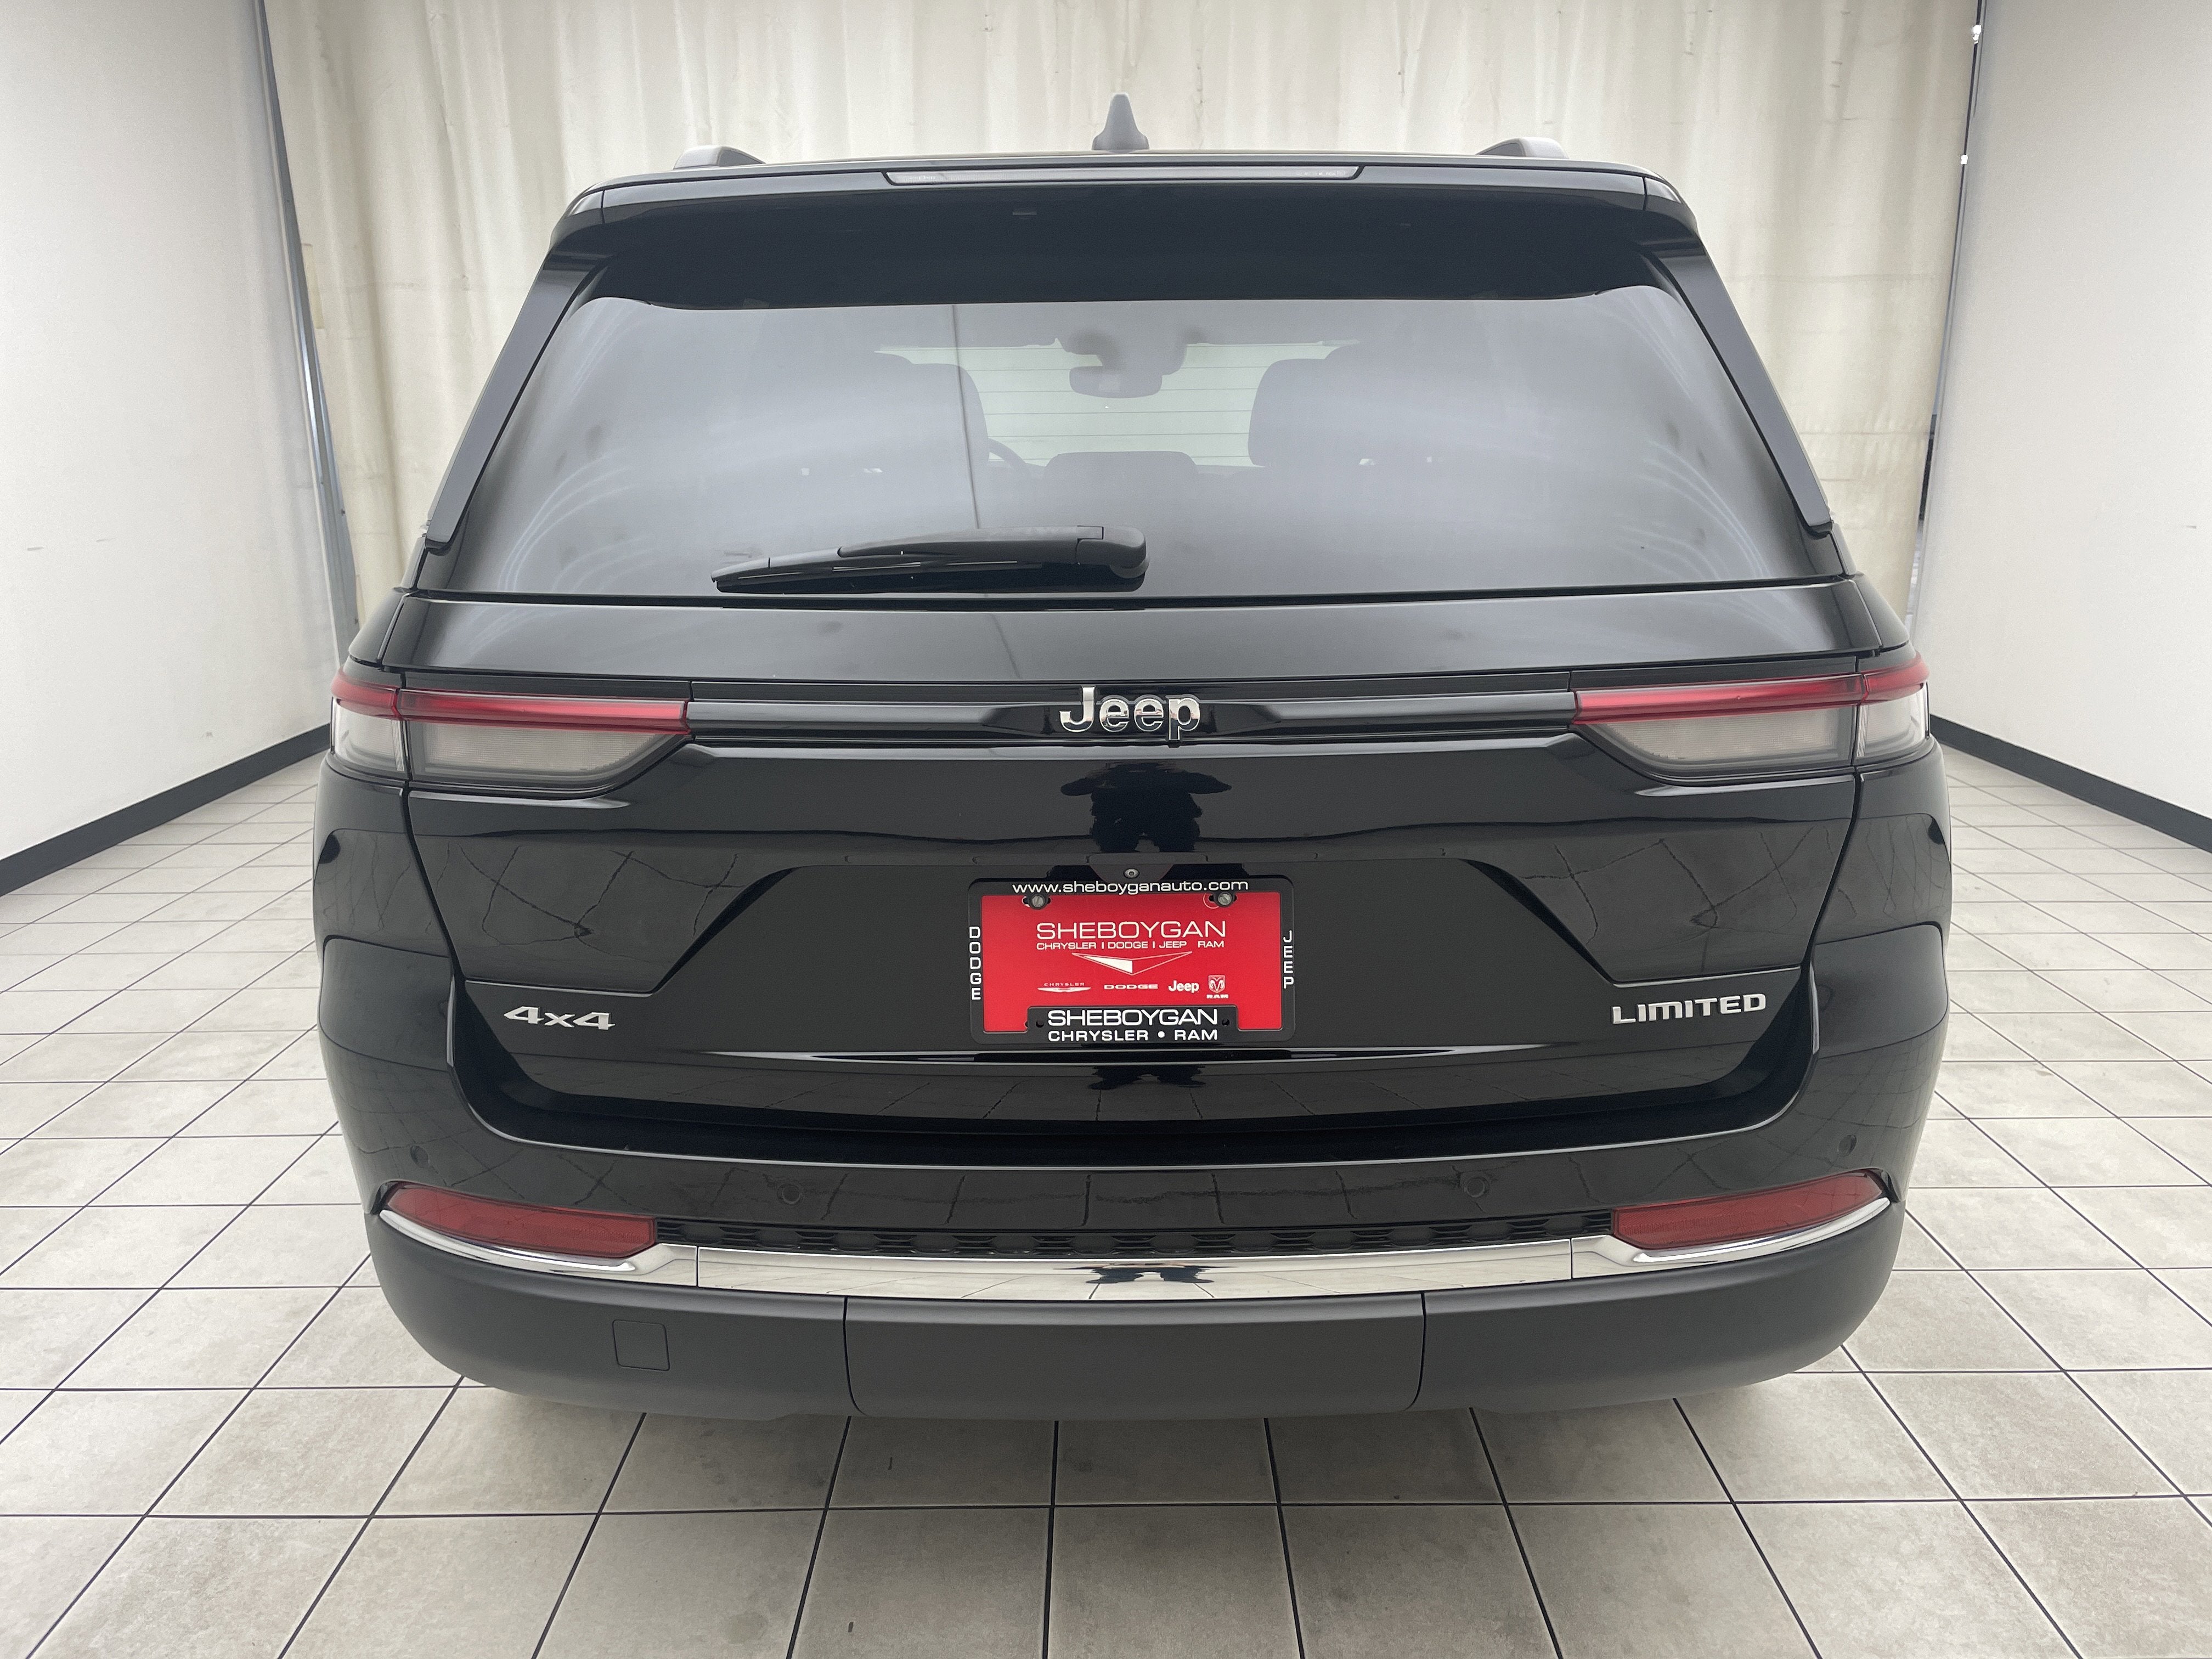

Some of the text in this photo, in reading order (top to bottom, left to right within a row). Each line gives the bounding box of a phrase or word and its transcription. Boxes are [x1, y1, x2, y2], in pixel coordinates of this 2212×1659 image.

[1059, 686, 1200, 741] Jeep
[1012, 881, 1249, 895] www.sheboyganauto.com
[1036, 921, 1226, 939] SHEBOYGAN
[969, 926, 981, 1000] DODGE
[1283, 930, 1294, 989] JEEP
[1168, 980, 1200, 994] Jeep
[504, 1006, 616, 1030] 4x4
[1048, 1008, 1218, 1026] SHEBOYGAN
[1611, 993, 1767, 1024] LIMITED
[1048, 1029, 1218, 1042] CHRYSLER RAM
